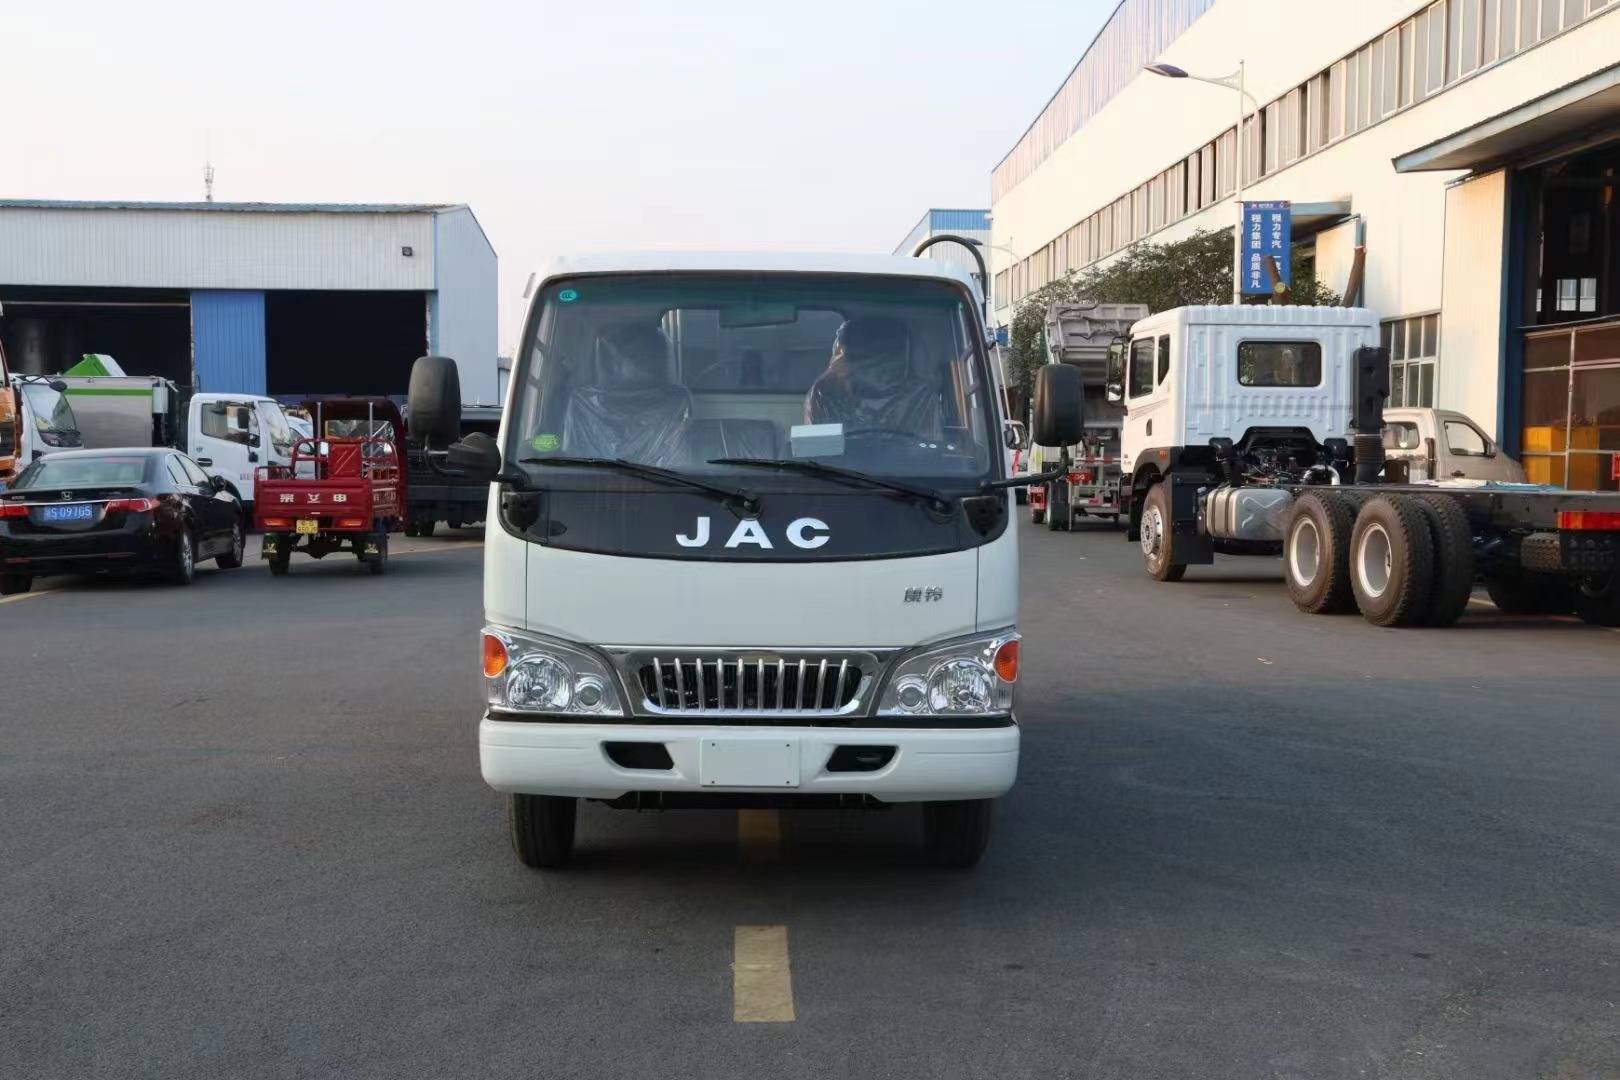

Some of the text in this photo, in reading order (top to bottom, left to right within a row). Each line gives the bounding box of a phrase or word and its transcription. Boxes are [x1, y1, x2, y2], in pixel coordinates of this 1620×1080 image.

[1251, 214, 1262, 249] 程力集团
[675, 516, 831, 549] JAC
